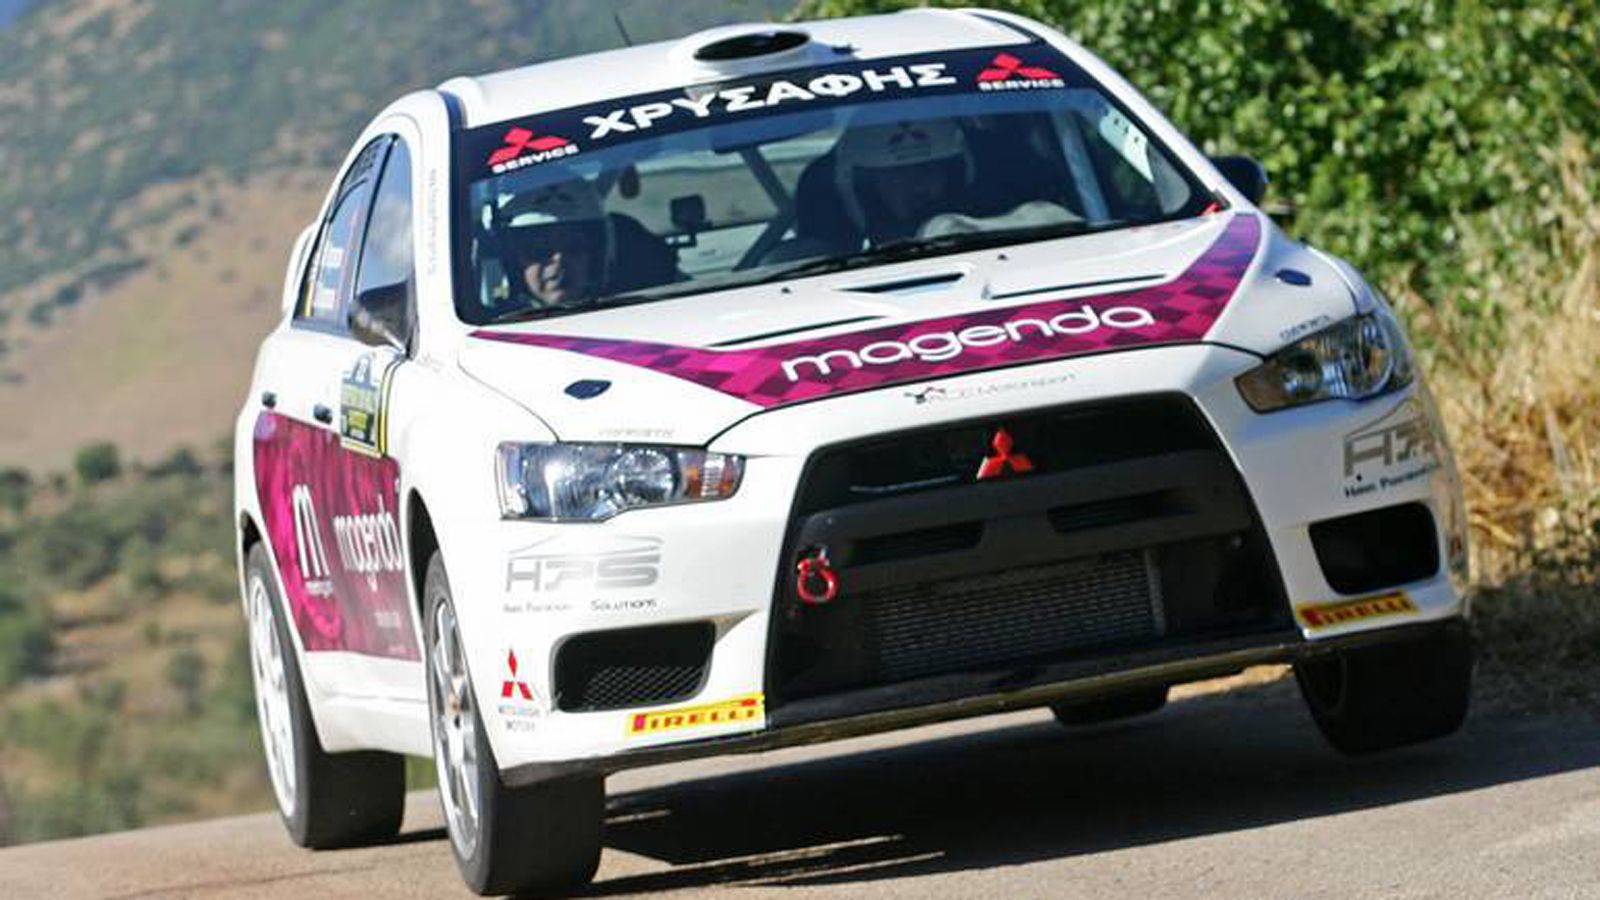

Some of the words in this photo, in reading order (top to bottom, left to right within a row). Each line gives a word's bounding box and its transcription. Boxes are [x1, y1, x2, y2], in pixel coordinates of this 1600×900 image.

[582, 63, 957, 139] ΧΡΥΣΑΦΗΣ
[977, 78, 1065, 92] SERVICE
[492, 143, 580, 174] SERVICE
[780, 304, 1156, 382] magenda
[1300, 590, 1411, 626] PIRELLI
[632, 698, 758, 732] PIRELLI
